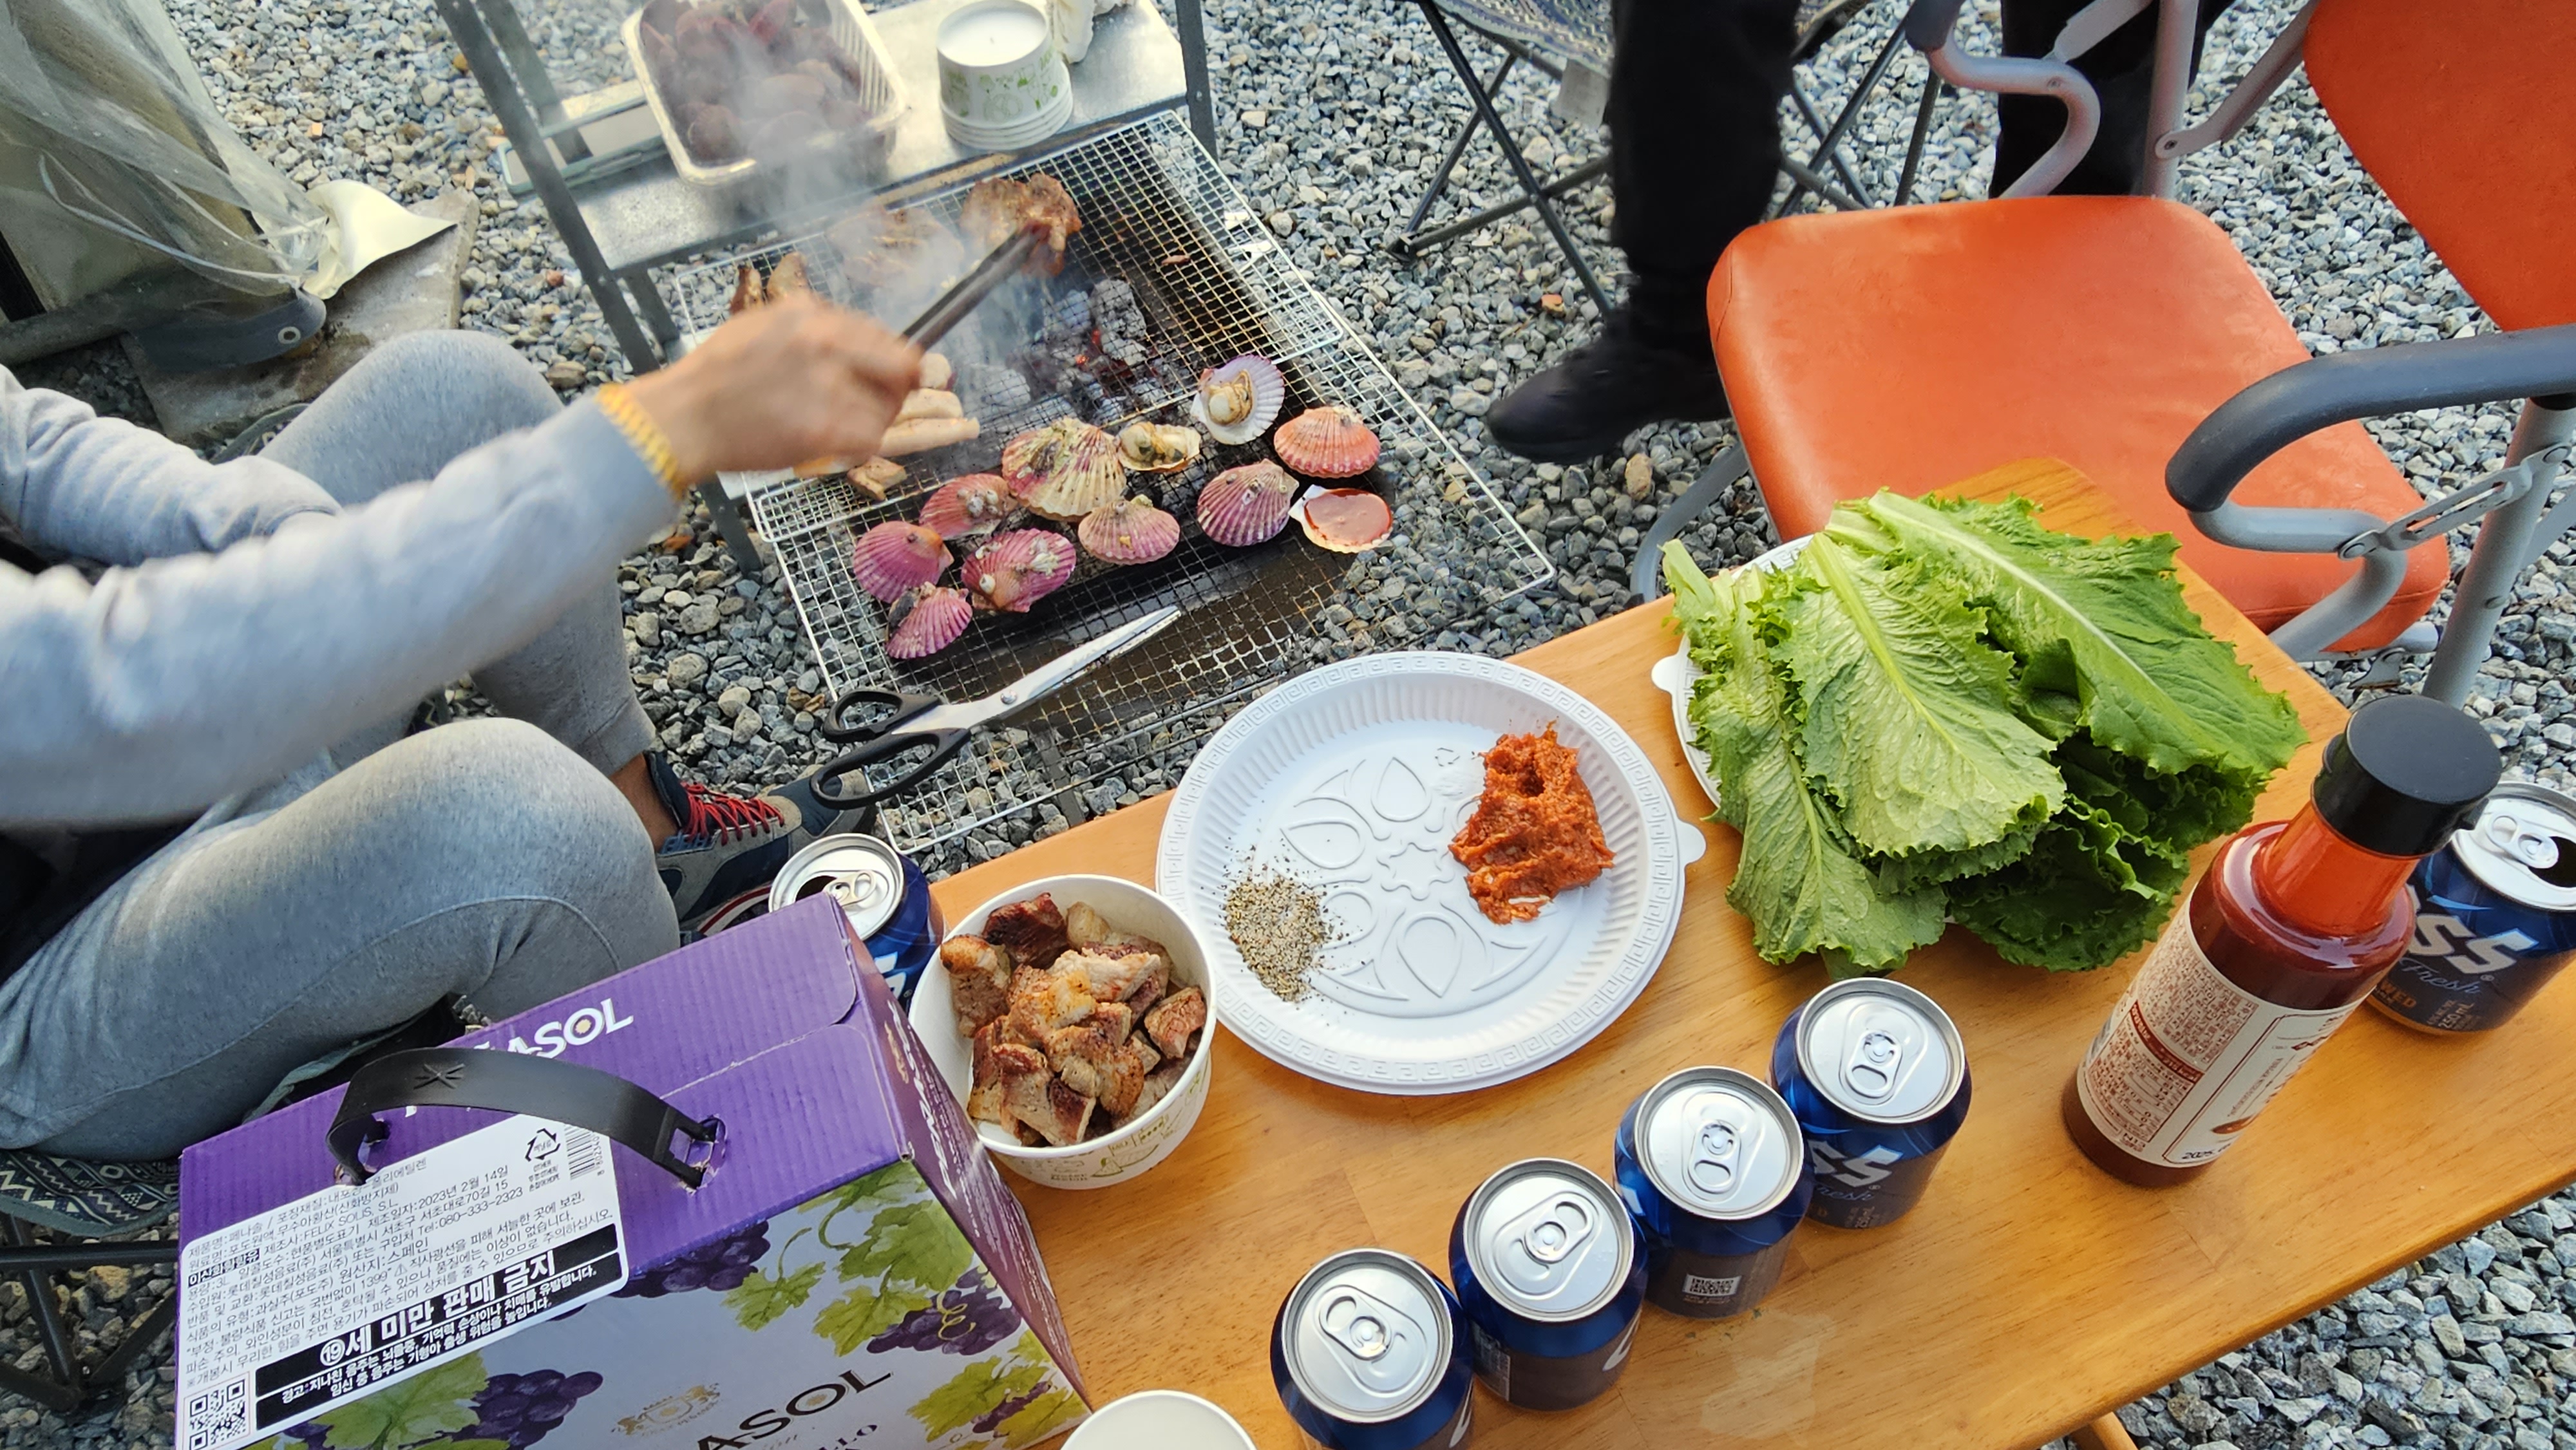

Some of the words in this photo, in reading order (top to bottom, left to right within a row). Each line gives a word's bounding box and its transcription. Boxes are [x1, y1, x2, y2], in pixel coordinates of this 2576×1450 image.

[2407, 884, 2539, 974] SS
[2380, 979, 2417, 1008] WED
[2399, 957, 2483, 994] Fresh
[368, 1185, 456, 1227] 제조일자:2023년
[461, 1176, 478, 1192] 2월
[484, 1165, 507, 1182] 14일
[1807, 1139, 1904, 1187] SS
[271, 1305, 305, 1326] 신고는
[310, 1282, 355, 1308] 국번없이
[410, 1238, 466, 1267] 직사광선을
[470, 1227, 493, 1245] 피해
[497, 1212, 529, 1234] 서늘한
[533, 1201, 556, 1221] 곳에
[560, 1191, 584, 1209] 보관.
[320, 1229, 377, 1260] 서울특별시
[381, 1215, 415, 1236] 서초구
[420, 1185, 489, 1221] 서초대로70길
[495, 1178, 507, 1191] 15
[186, 1357, 207, 1373] 파손
[245, 1317, 304, 1349] 와인성분이
[380, 1283, 391, 1295] 수
[396, 1266, 430, 1290] 있으나
[436, 1249, 481, 1274] 품질에는
[486, 1230, 520, 1252] 이상이
[525, 1210, 573, 1238] 없습니다.
[187, 1310, 208, 1328] 반품
[214, 1303, 225, 1317] 및
[352, 1247, 375, 1262] 또는
[379, 1229, 413, 1251] 구입처
[187, 1320, 221, 1341] 식품의
[339, 1236, 428, 1284] 원산지:스페인
[238, 1344, 272, 1367] 무리한
[278, 1333, 299, 1352] 힘을
[305, 1322, 328, 1340] 주면
[334, 1306, 367, 1330] 용기가
[372, 1286, 418, 1312] 파손되어
[423, 1270, 457, 1293] 상처를
[477, 1259, 488, 1270] 수
[493, 1238, 538, 1265] 있으므로
[381, 1300, 433, 1339] 미만
[443, 1274, 495, 1317] 판매
[503, 1250, 554, 1293] 금지
[330, 1377, 352, 1397] 임신
[355, 1371, 368, 1386] 중
[371, 1358, 404, 1380] 음주는
[408, 1341, 440, 1363] 기형아
[444, 1330, 466, 1350] 출생
[469, 1315, 501, 1338] 위험을
[346, 1355, 379, 1377] 음주는
[422, 1322, 454, 1347] 기억력
[458, 1303, 501, 1330] 손상이나
[504, 1288, 536, 1310] 치매를
[698, 1369, 892, 1450] ASOL
